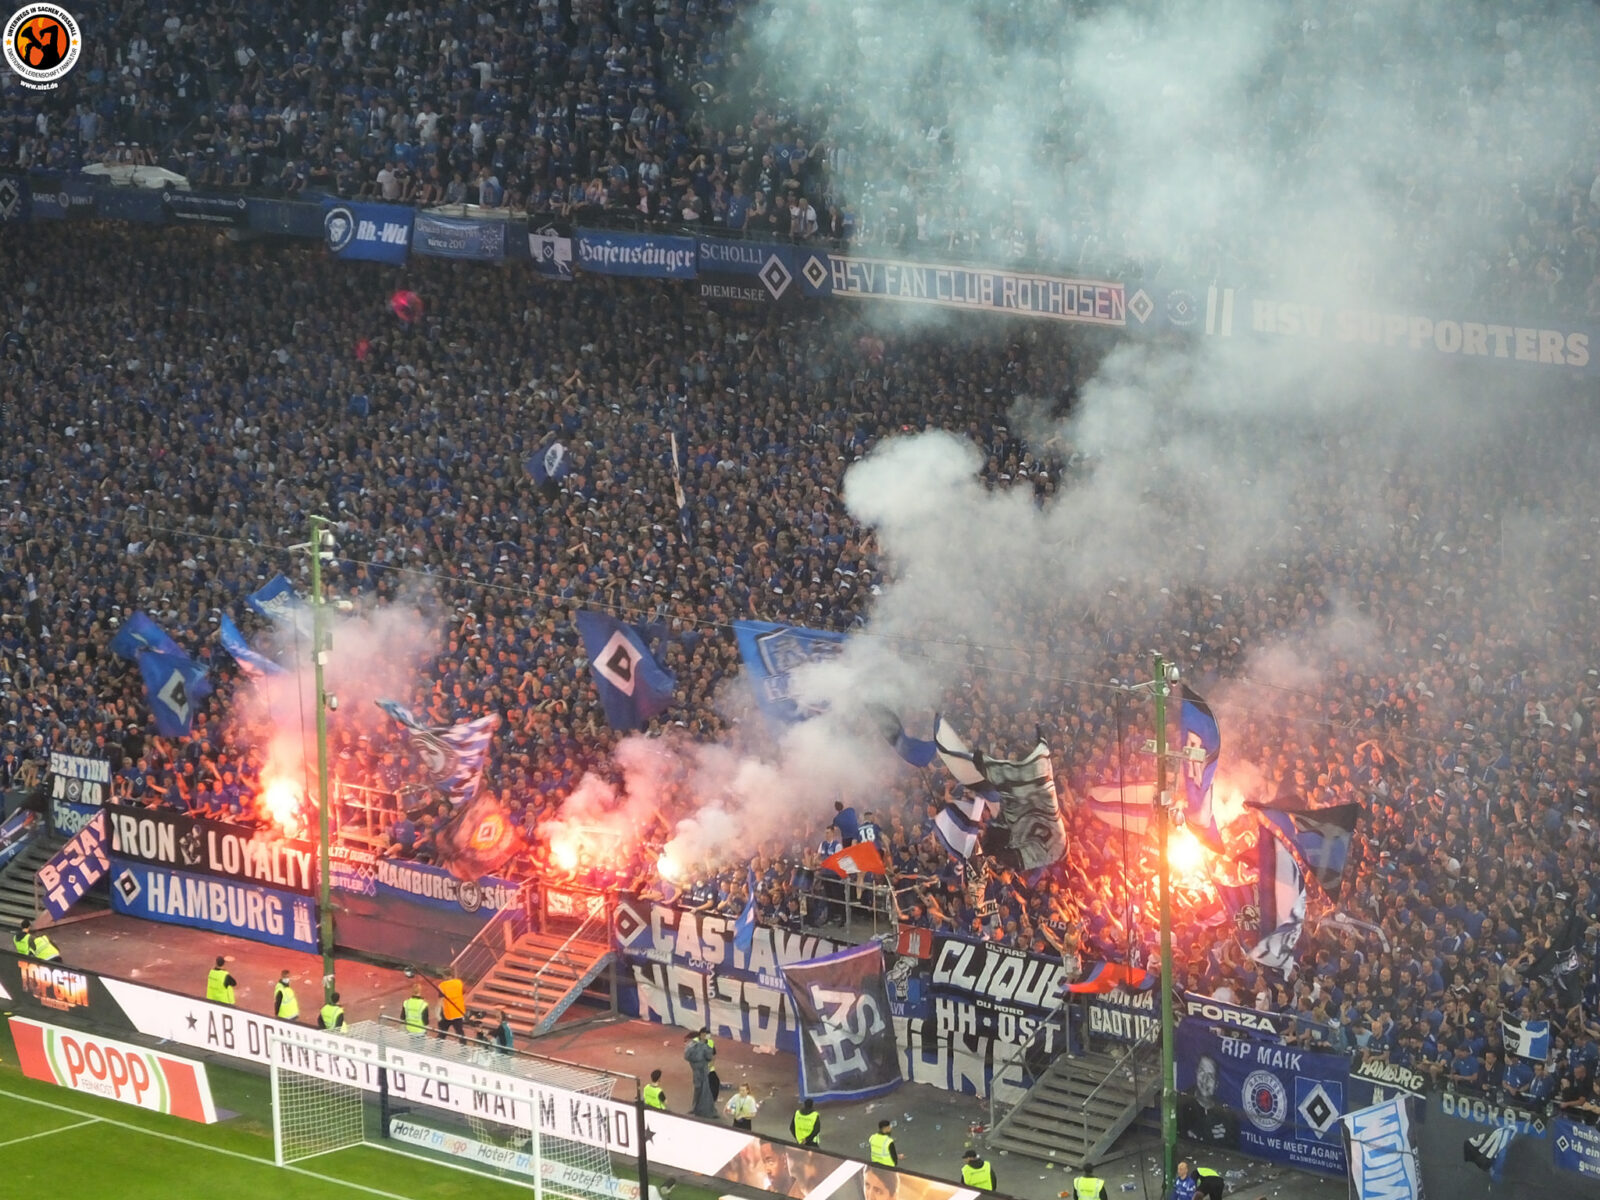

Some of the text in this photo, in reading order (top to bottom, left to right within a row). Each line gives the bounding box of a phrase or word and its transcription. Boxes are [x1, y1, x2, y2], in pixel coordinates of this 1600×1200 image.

[700, 243, 763, 264] SCHOLLI
[700, 284, 766, 302] DIEMELSEE
[830, 259, 875, 292] HSV
[884, 264, 928, 298] FAN
[935, 269, 994, 305] CLUB
[1001, 279, 1126, 320] ROTHOSEN
[1249, 299, 1324, 339] HSV
[1334, 308, 1590, 367] SUPPORTERS
[110, 812, 312, 890] IRON LOYALTY
[376, 859, 459, 902] HAMBURG
[147, 871, 284, 936] HAMBURG
[985, 942, 1027, 958] ULTRAS
[932, 939, 1067, 1009] CLIQUE
[976, 999, 1025, 1016] DU NORD
[1187, 1001, 1278, 1034] FORZA
[60, 1035, 150, 1105] POPP
[1221, 1039, 1303, 1072] RIP MAIK
[1357, 1060, 1425, 1090] HAMBURG
[207, 1010, 235, 1050] AB
[247, 1019, 406, 1093] DONNERSTG
[472, 1073, 516, 1121] MAI
[569, 1097, 630, 1148] KINO
[393, 1121, 430, 1142] Hotel?
[430, 1131, 467, 1153] trivago
[476, 1144, 516, 1165] Hotel?
[1266, 1137, 1281, 1149] WE
[1283, 1141, 1309, 1154] MEET
